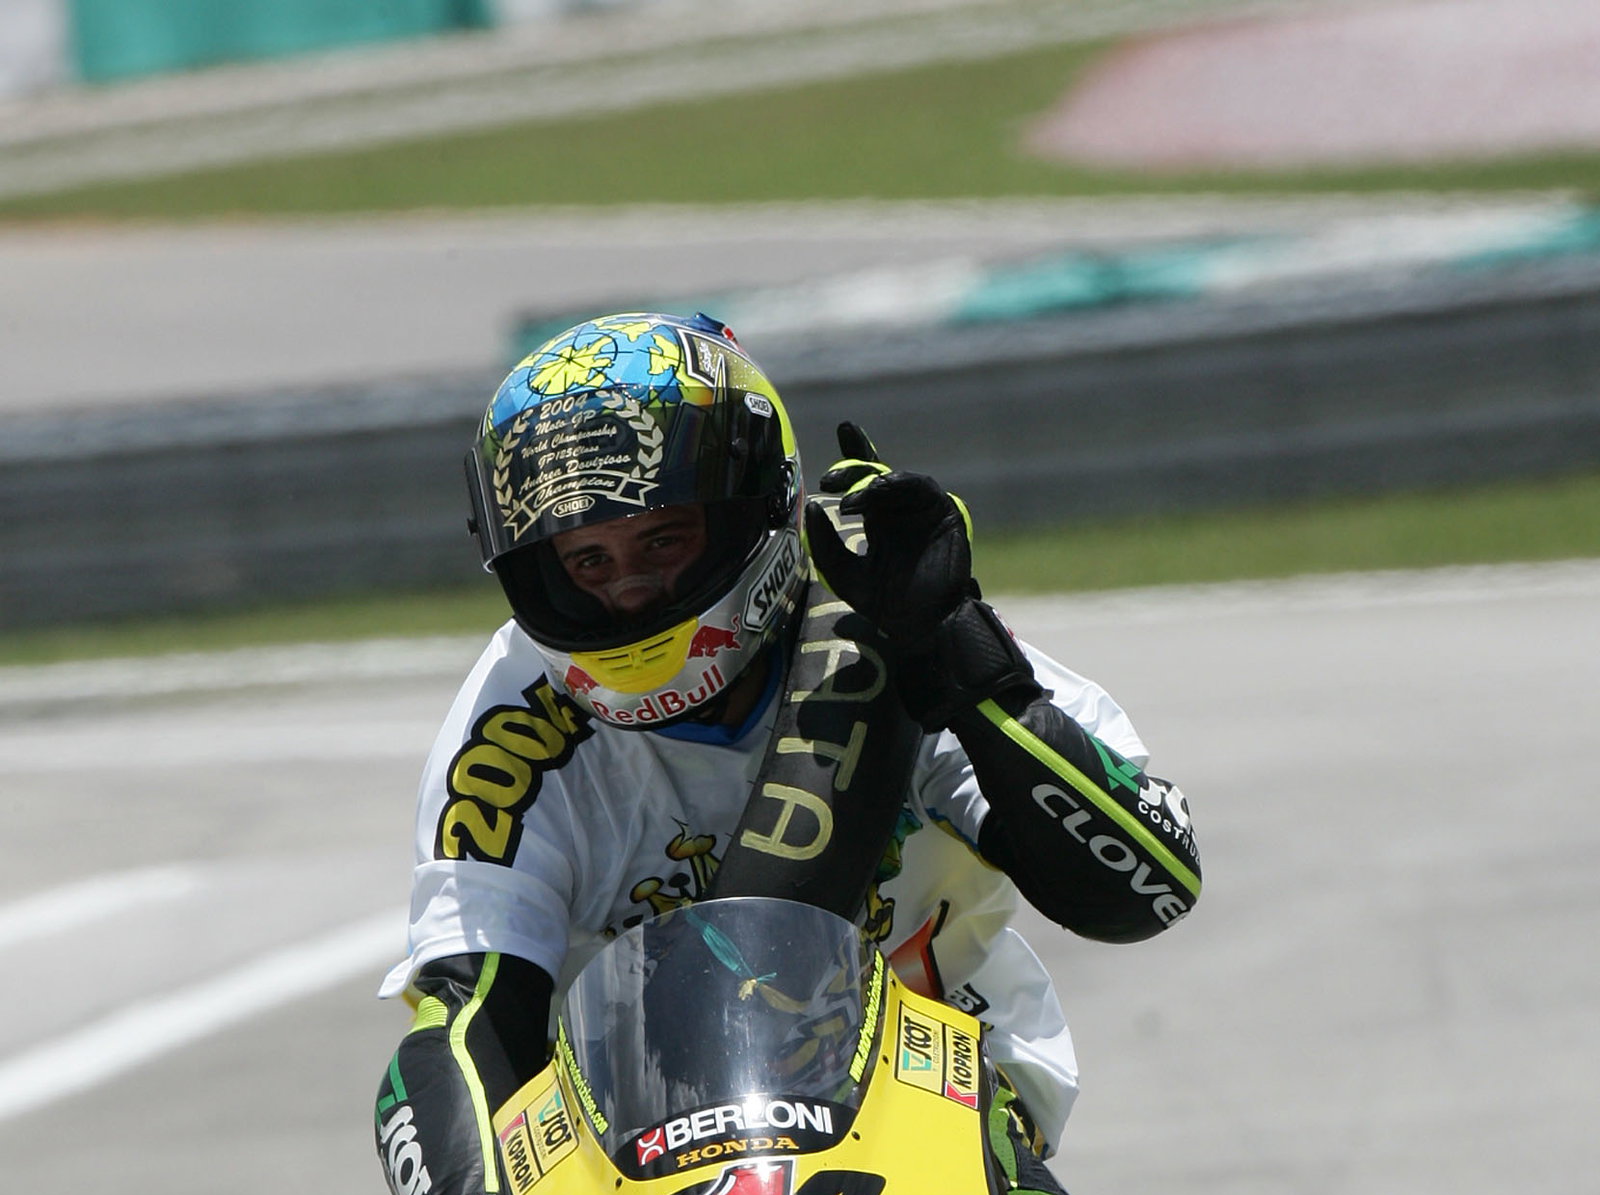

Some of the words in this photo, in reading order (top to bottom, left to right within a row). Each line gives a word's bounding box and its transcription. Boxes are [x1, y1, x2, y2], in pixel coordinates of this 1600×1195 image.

[535, 420, 566, 435] Moto
[572, 409, 597, 428] GP
[540, 393, 588, 420] 2004
[521, 441, 548, 459] World
[551, 424, 617, 448] Championship
[519, 467, 562, 495] Andrea
[566, 456, 631, 473] Dovizioso
[533, 477, 615, 508] Champion
[557, 499, 589, 515] SHOEI
[752, 538, 797, 621] SHOEI
[1031, 783, 1190, 927] CLOVE
[952, 1030, 972, 1090] KOPRON
[666, 1099, 834, 1151] BERLONI
[505, 1130, 535, 1193] KOPRON
[677, 1137, 799, 1168] HONDA
